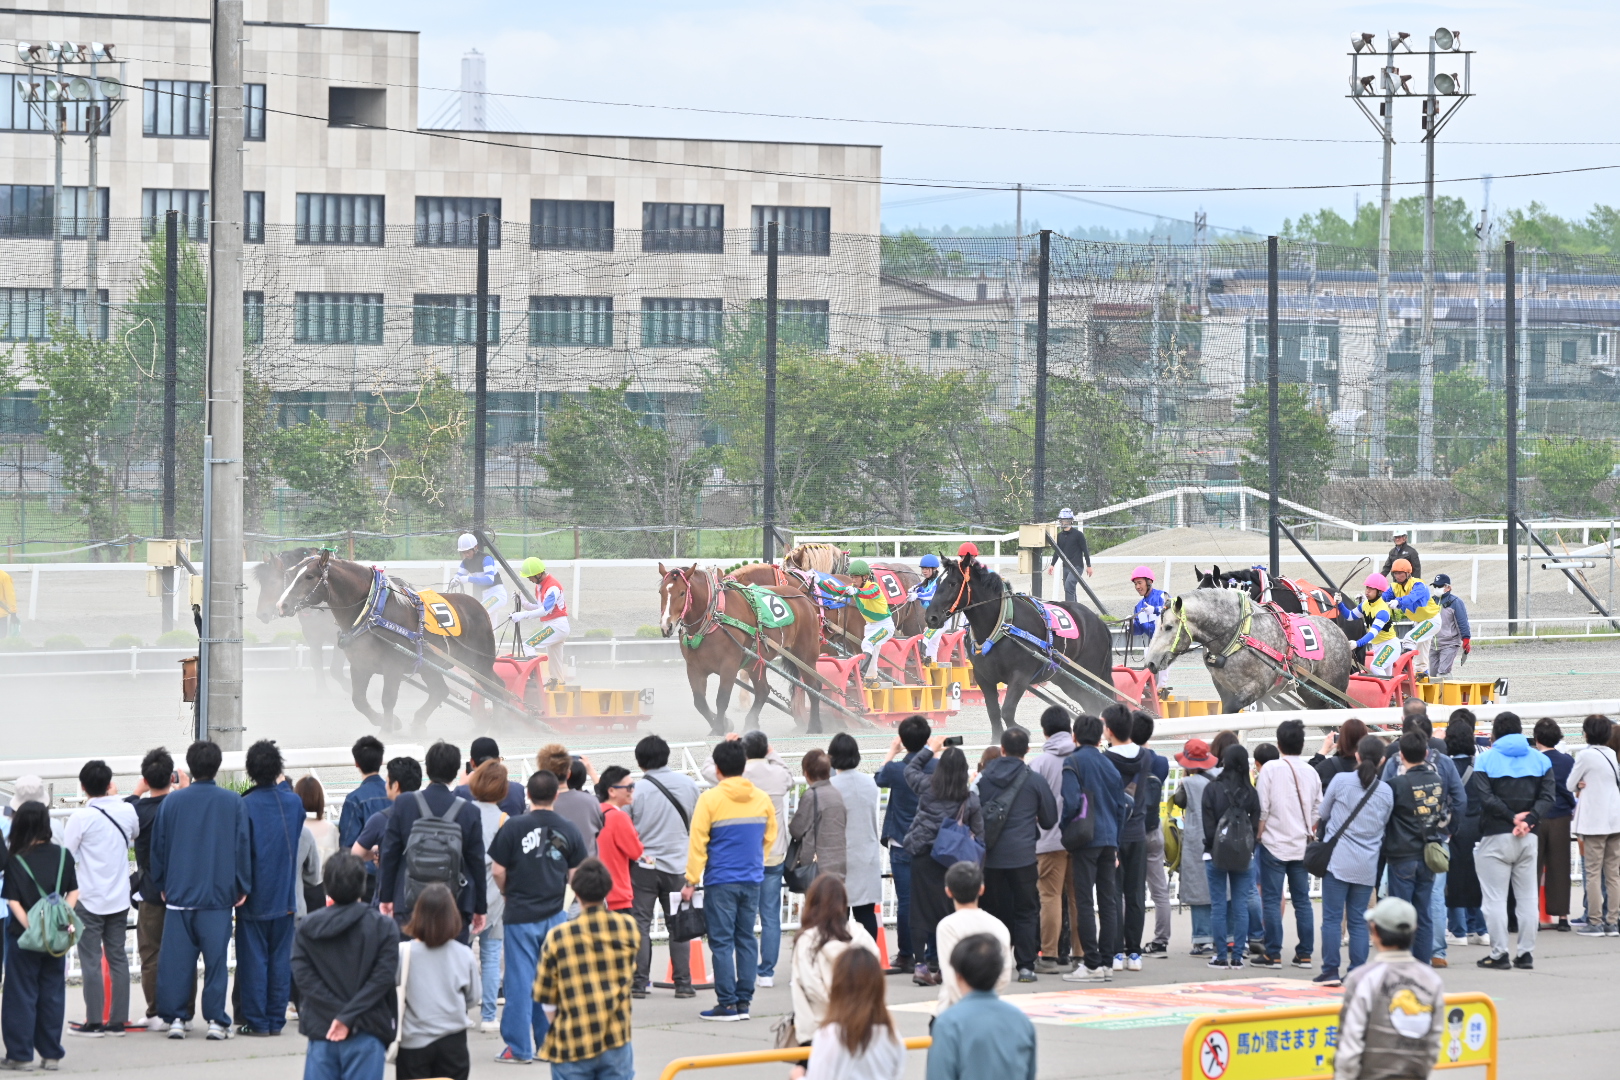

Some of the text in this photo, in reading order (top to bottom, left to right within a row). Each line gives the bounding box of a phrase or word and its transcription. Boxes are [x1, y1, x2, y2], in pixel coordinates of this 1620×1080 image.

[882, 574, 900, 598] 3
[769, 595, 786, 618] 6
[1310, 589, 1327, 611] 7
[430, 603, 455, 628] 5
[1051, 608, 1072, 630] 8
[1298, 625, 1319, 651] 9
[645, 688, 654, 704] 5
[952, 682, 961, 699] 6
[1500, 678, 1508, 695] 7
[1236, 1027, 1319, 1055] 馬が驚きます
